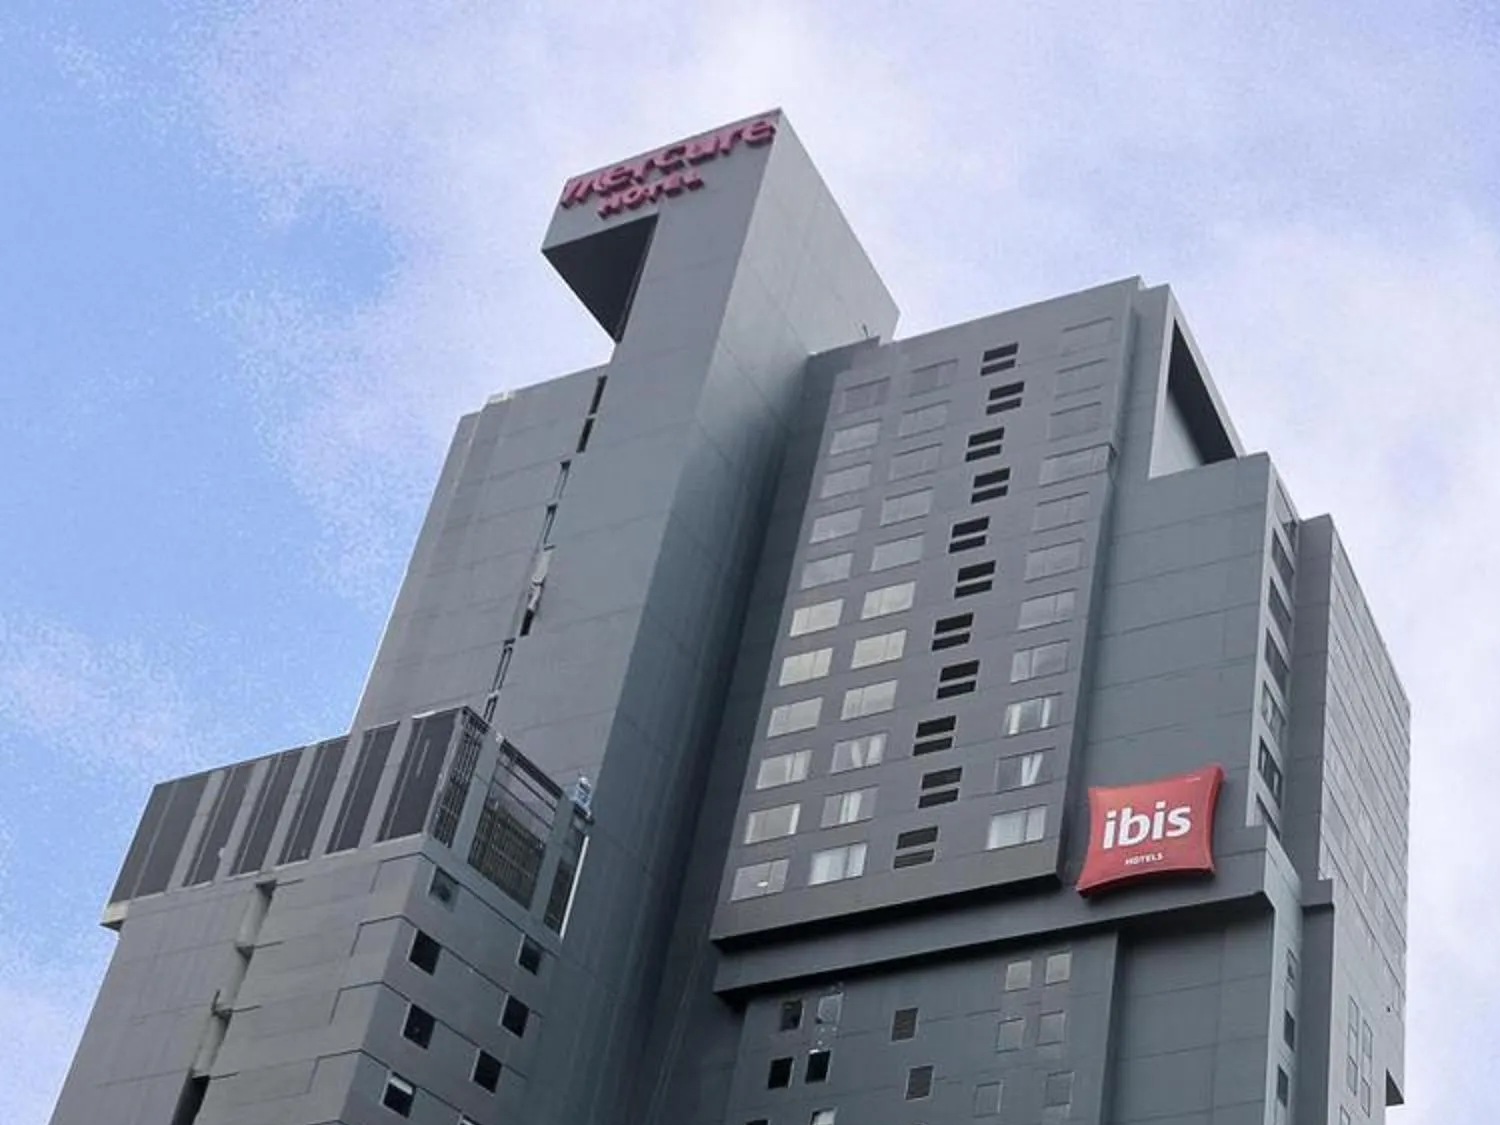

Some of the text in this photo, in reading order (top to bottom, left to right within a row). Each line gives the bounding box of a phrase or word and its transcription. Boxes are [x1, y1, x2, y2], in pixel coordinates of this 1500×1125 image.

[562, 119, 776, 208] mercure
[1102, 801, 1192, 850] ibis
[1124, 852, 1164, 865] HOTELS
